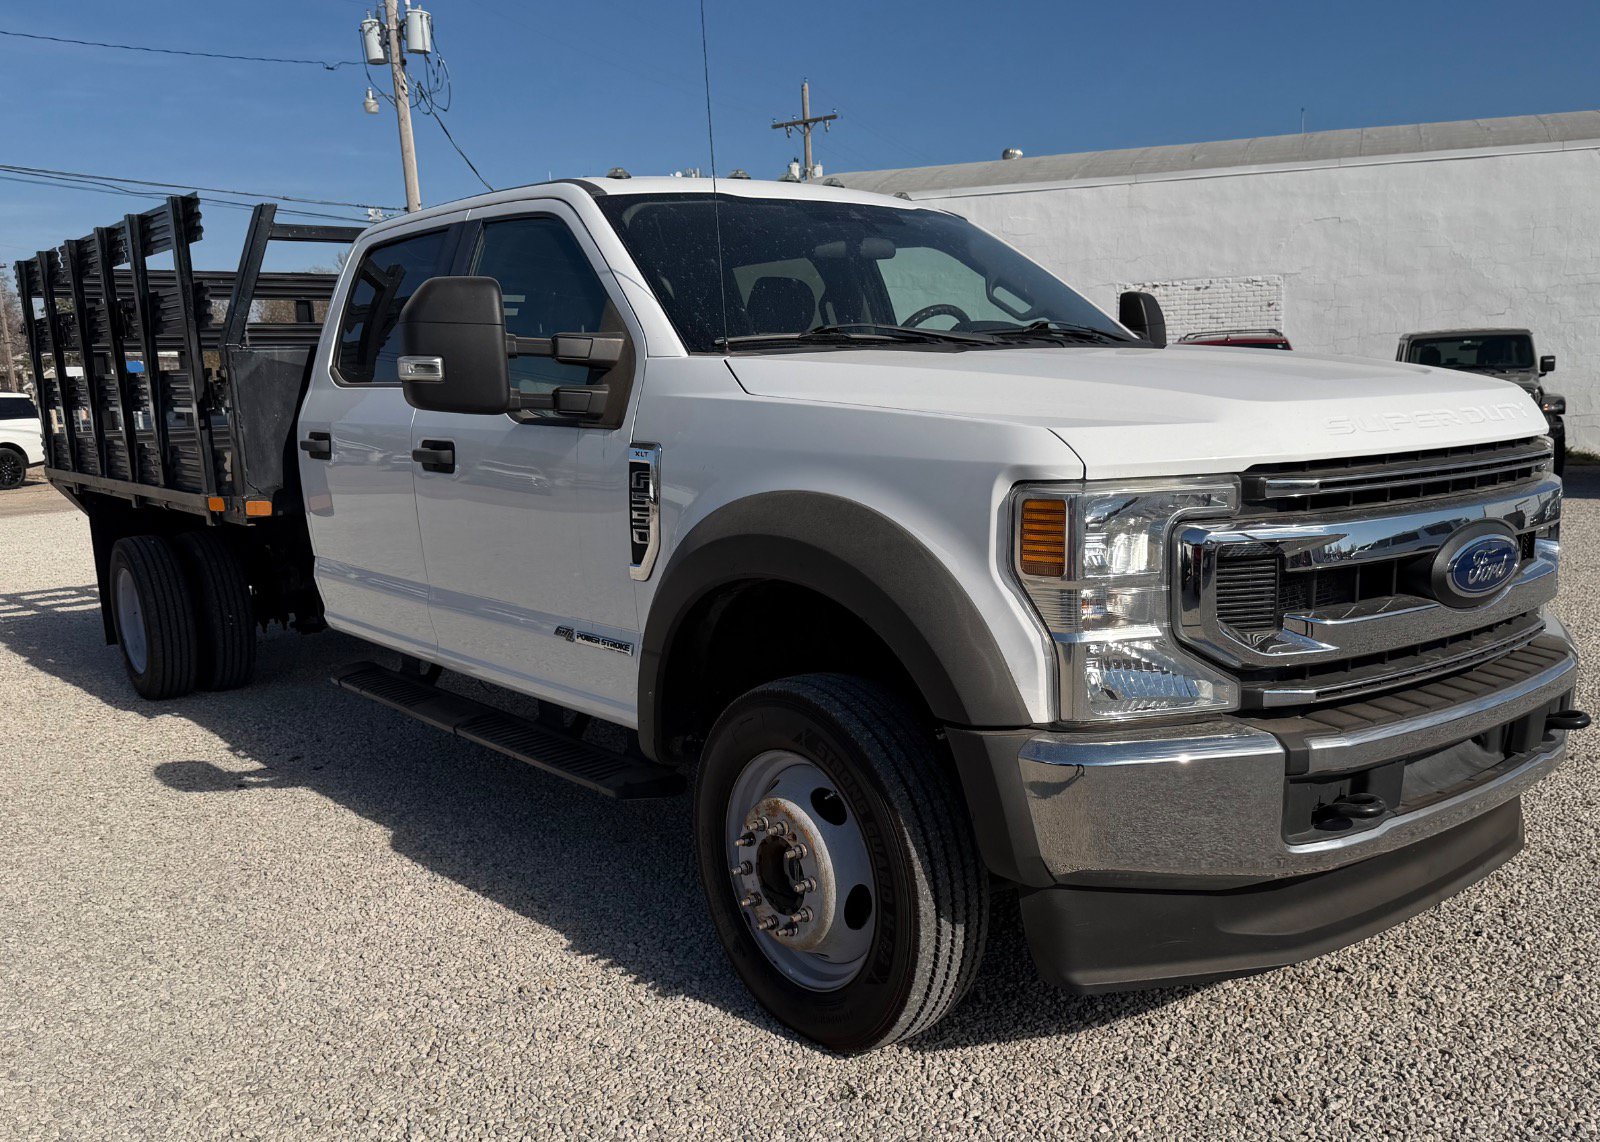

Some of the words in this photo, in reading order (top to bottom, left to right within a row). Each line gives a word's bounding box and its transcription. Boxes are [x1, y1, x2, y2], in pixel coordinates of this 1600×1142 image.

[634, 450, 649, 458] XLT
[1467, 547, 1508, 585] Ford
[576, 632, 601, 644] POWER
[601, 638, 631, 652] STROKE
